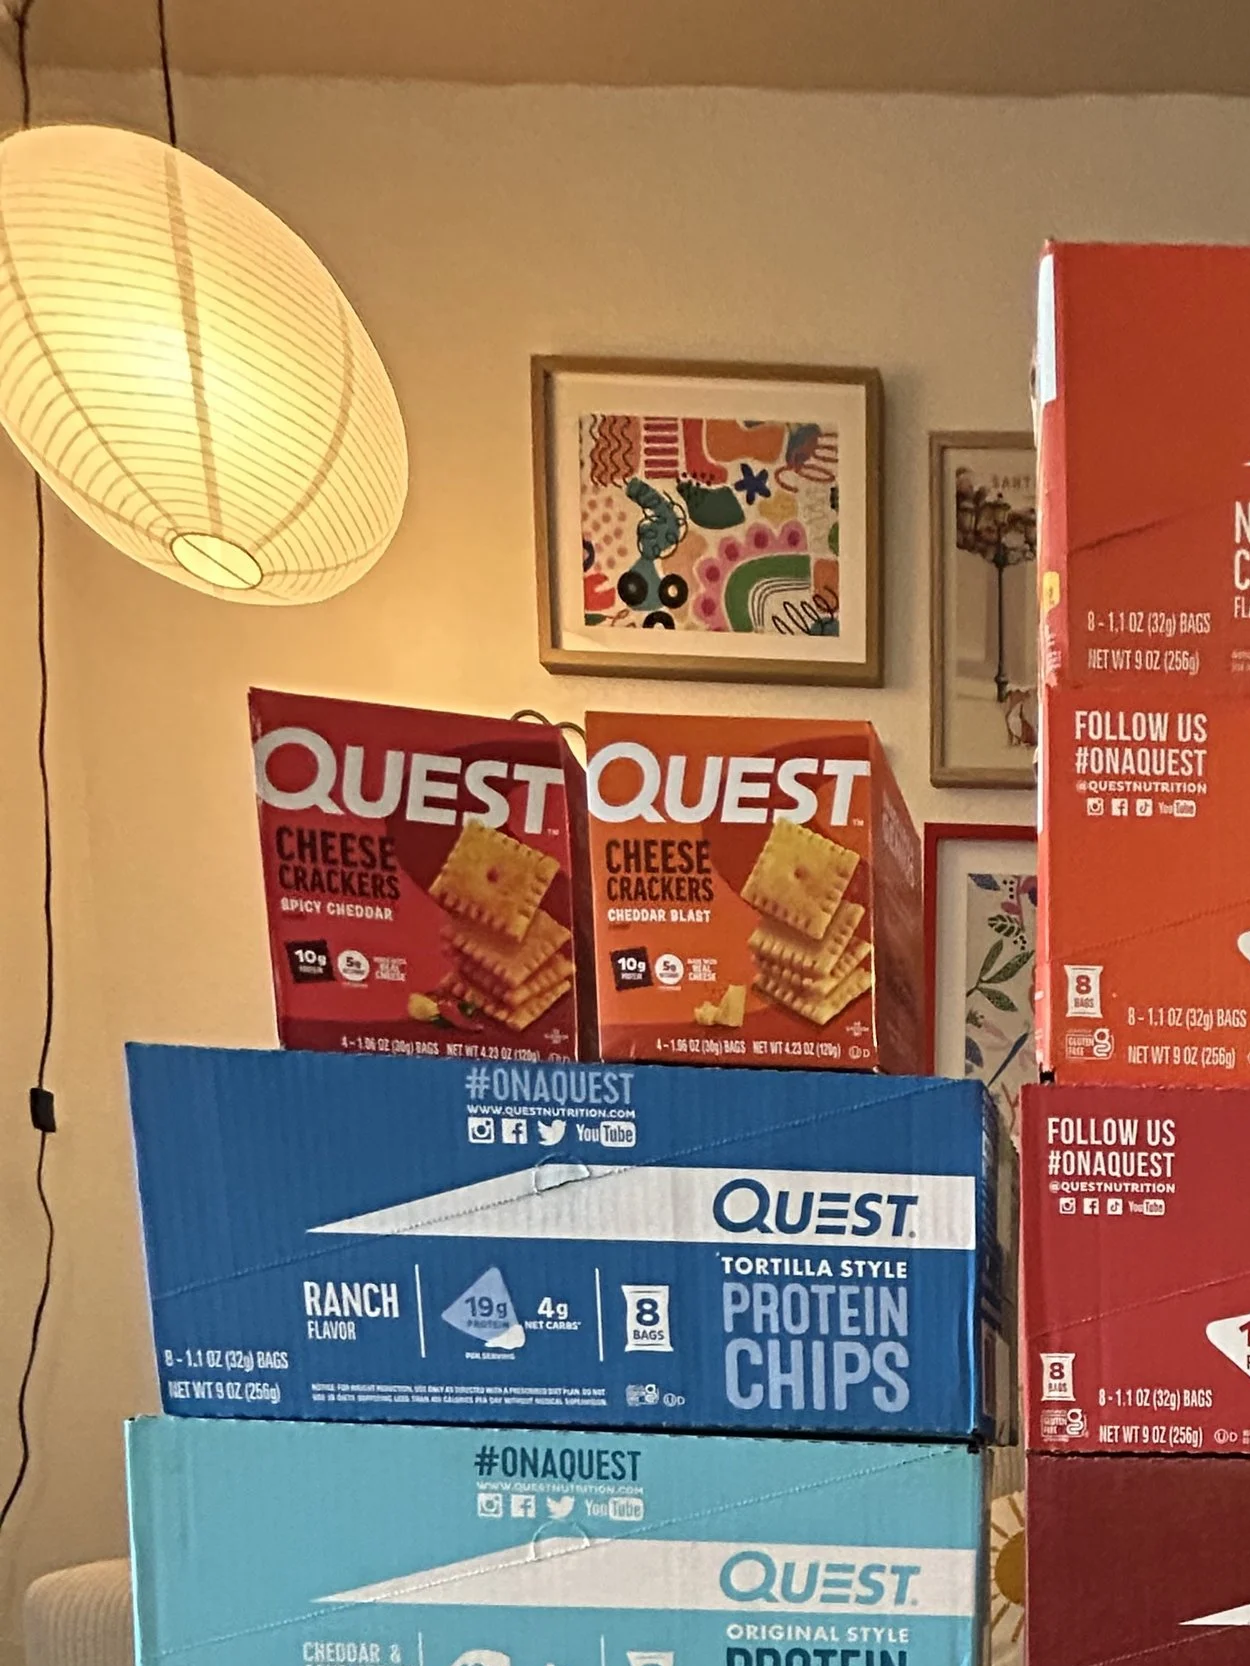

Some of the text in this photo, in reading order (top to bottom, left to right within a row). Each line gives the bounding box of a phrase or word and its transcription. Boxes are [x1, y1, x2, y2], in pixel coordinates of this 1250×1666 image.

[1074, 711, 1208, 744] FOLLOW US
[1074, 746, 1207, 777] #ONAQUEST
[253, 727, 564, 835] QUEST
[586, 742, 871, 826] QUEST
[276, 826, 398, 871] CHEESE
[605, 840, 712, 874] CHEESE
[278, 865, 400, 899] CRACKERS
[607, 876, 714, 901] CRACKERS
[327, 902, 393, 921] CHEDDAR
[608, 909, 711, 922] CHEDDAR BLAST
[466, 1068, 634, 1104] #ONAQUEST
[1047, 1117, 1175, 1146] FOLLOW US
[1047, 1150, 1175, 1177] #ONAQUEST
[1049, 1180, 1175, 1192] @QUESTNUTRITION
[713, 1178, 918, 1237] QUEST
[721, 1257, 908, 1279] TORTILLA STYLE
[304, 1281, 398, 1319] RANCH
[636, 1298, 659, 1324] 8
[723, 1283, 908, 1335] PROTEIN
[724, 1342, 910, 1412] CHIPS
[1050, 1362, 1064, 1379] 8
[475, 1448, 640, 1482] #ONAQUEST
[718, 1551, 922, 1607] QUEST
[726, 1622, 909, 1644] ORIGINAL STYLE
